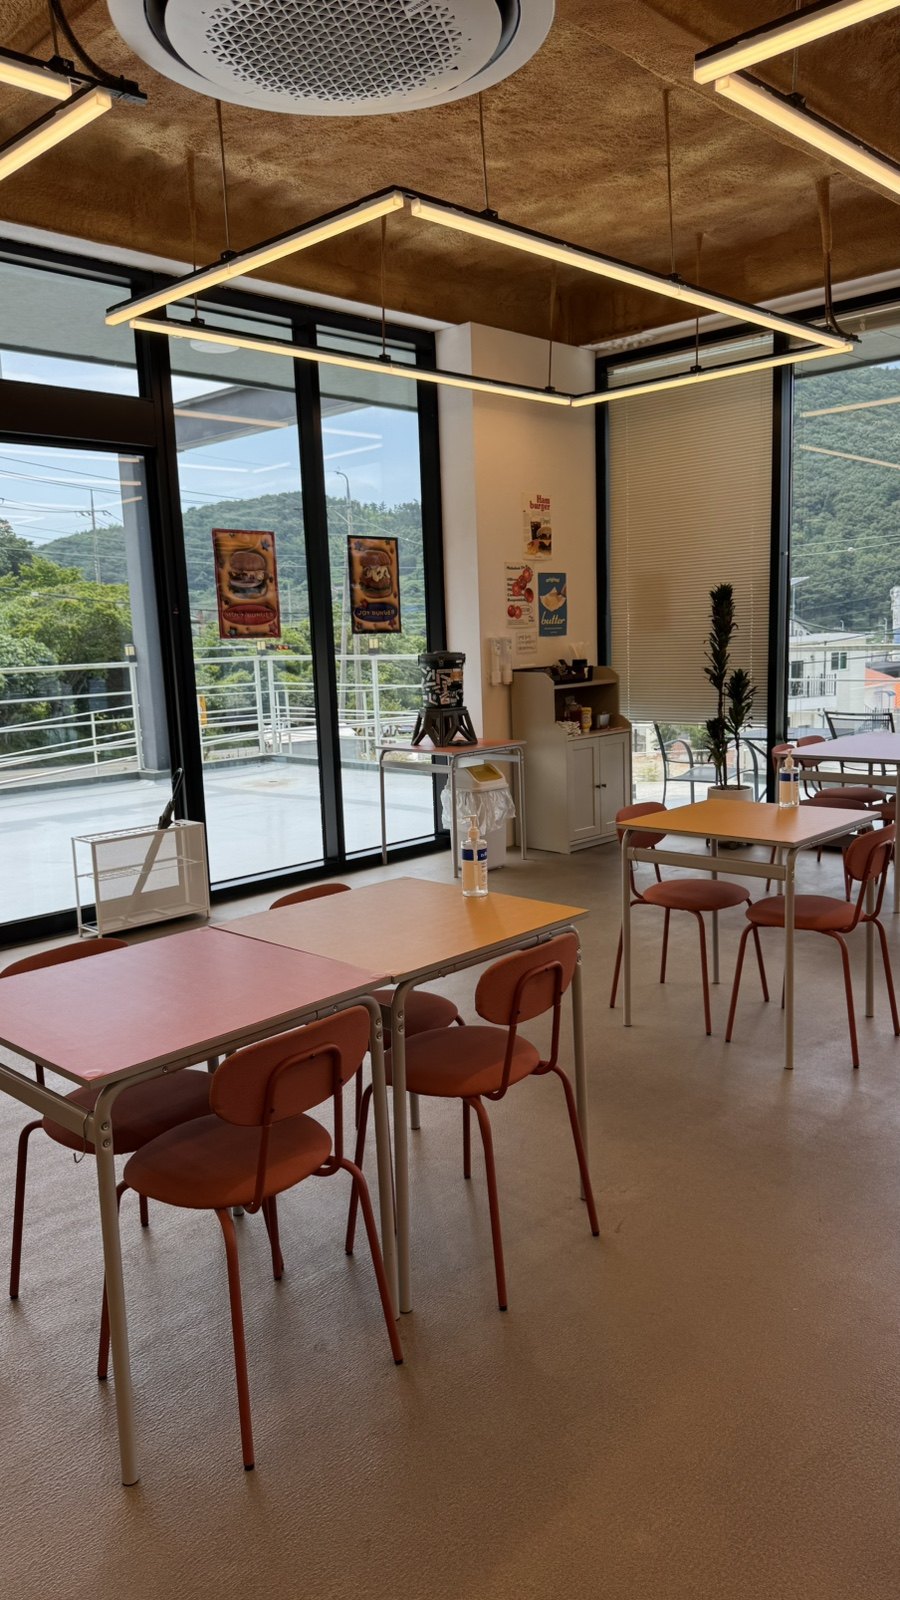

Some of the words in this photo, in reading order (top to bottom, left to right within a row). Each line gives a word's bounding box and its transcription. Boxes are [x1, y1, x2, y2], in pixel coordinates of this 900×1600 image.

[536, 494, 550, 504] Ham
[529, 500, 550, 511] burger
[541, 611, 566, 625] butter
